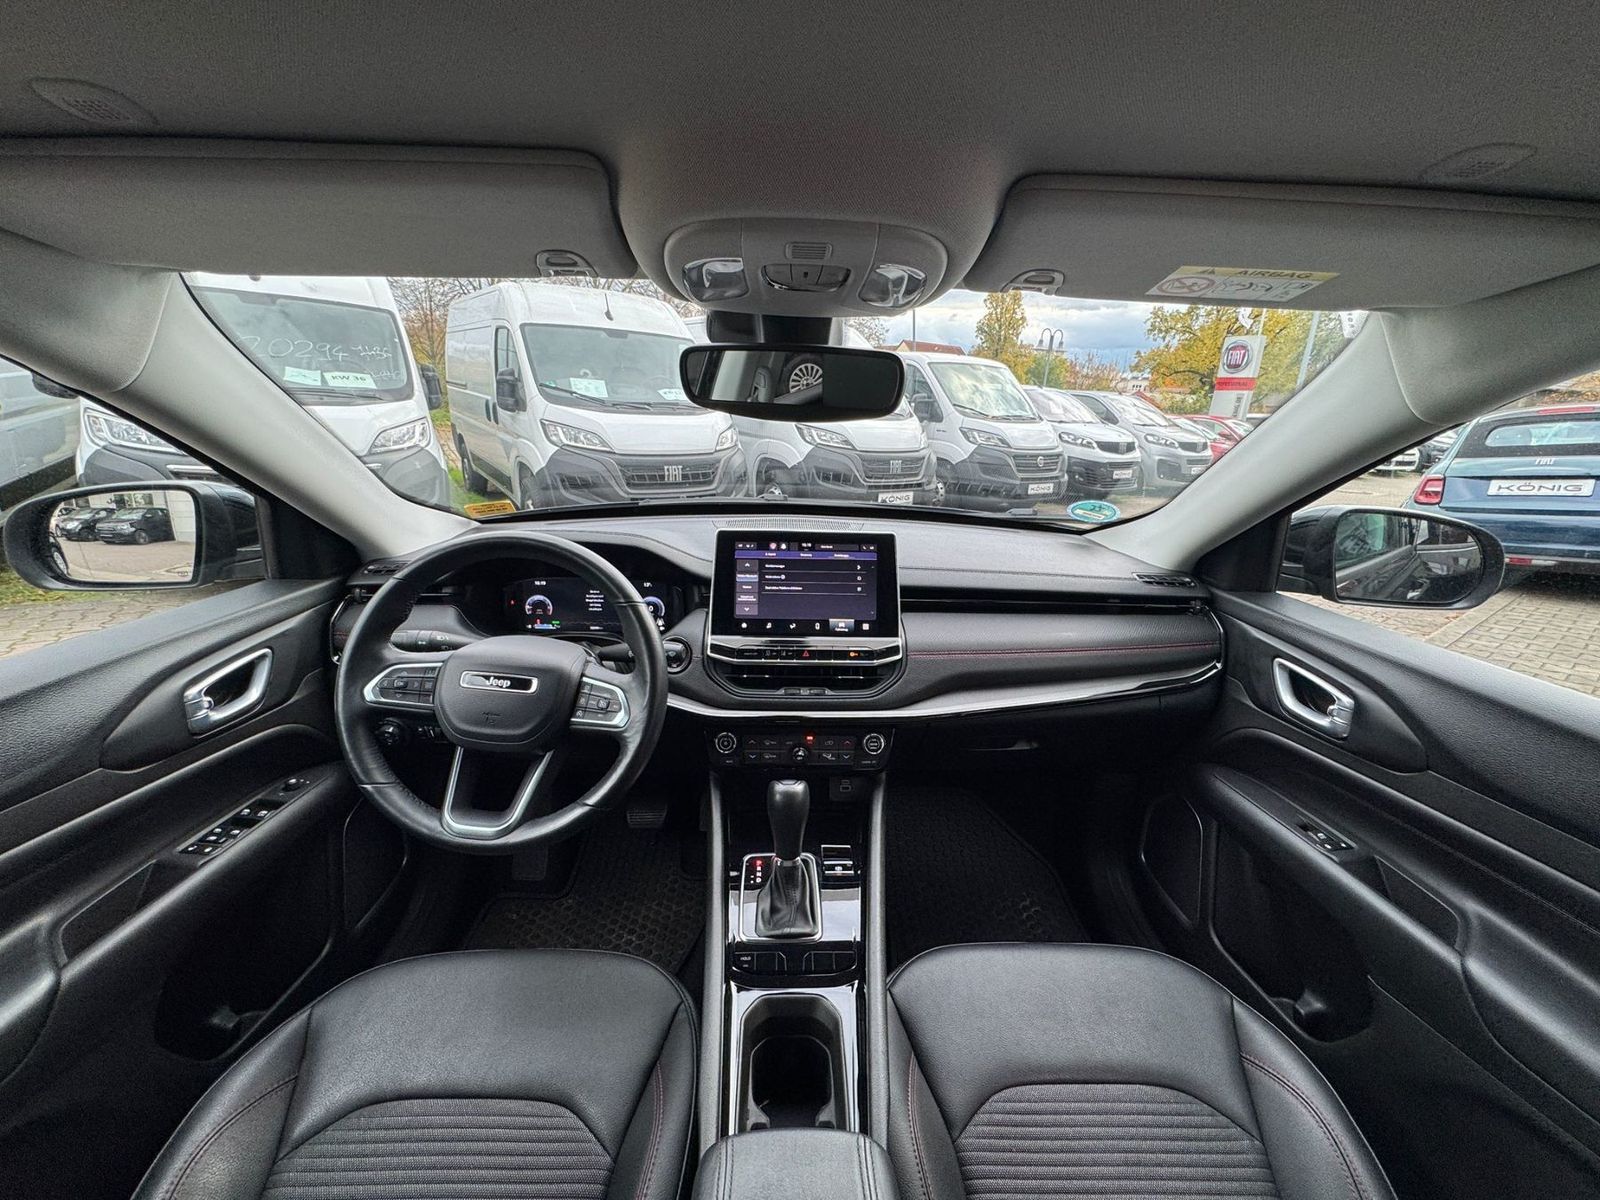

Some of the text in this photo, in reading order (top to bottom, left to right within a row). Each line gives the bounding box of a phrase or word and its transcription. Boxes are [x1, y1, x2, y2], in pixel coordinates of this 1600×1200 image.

[1236, 270, 1312, 279] AIRBAG
[1228, 350, 1245, 365] FIAT
[1535, 457, 1557, 466] FIAT
[664, 465, 684, 482] FIAT
[1497, 482, 1584, 492] KÖNIG
[881, 494, 911, 503] KÖNIG
[485, 676, 511, 689] Jeep
